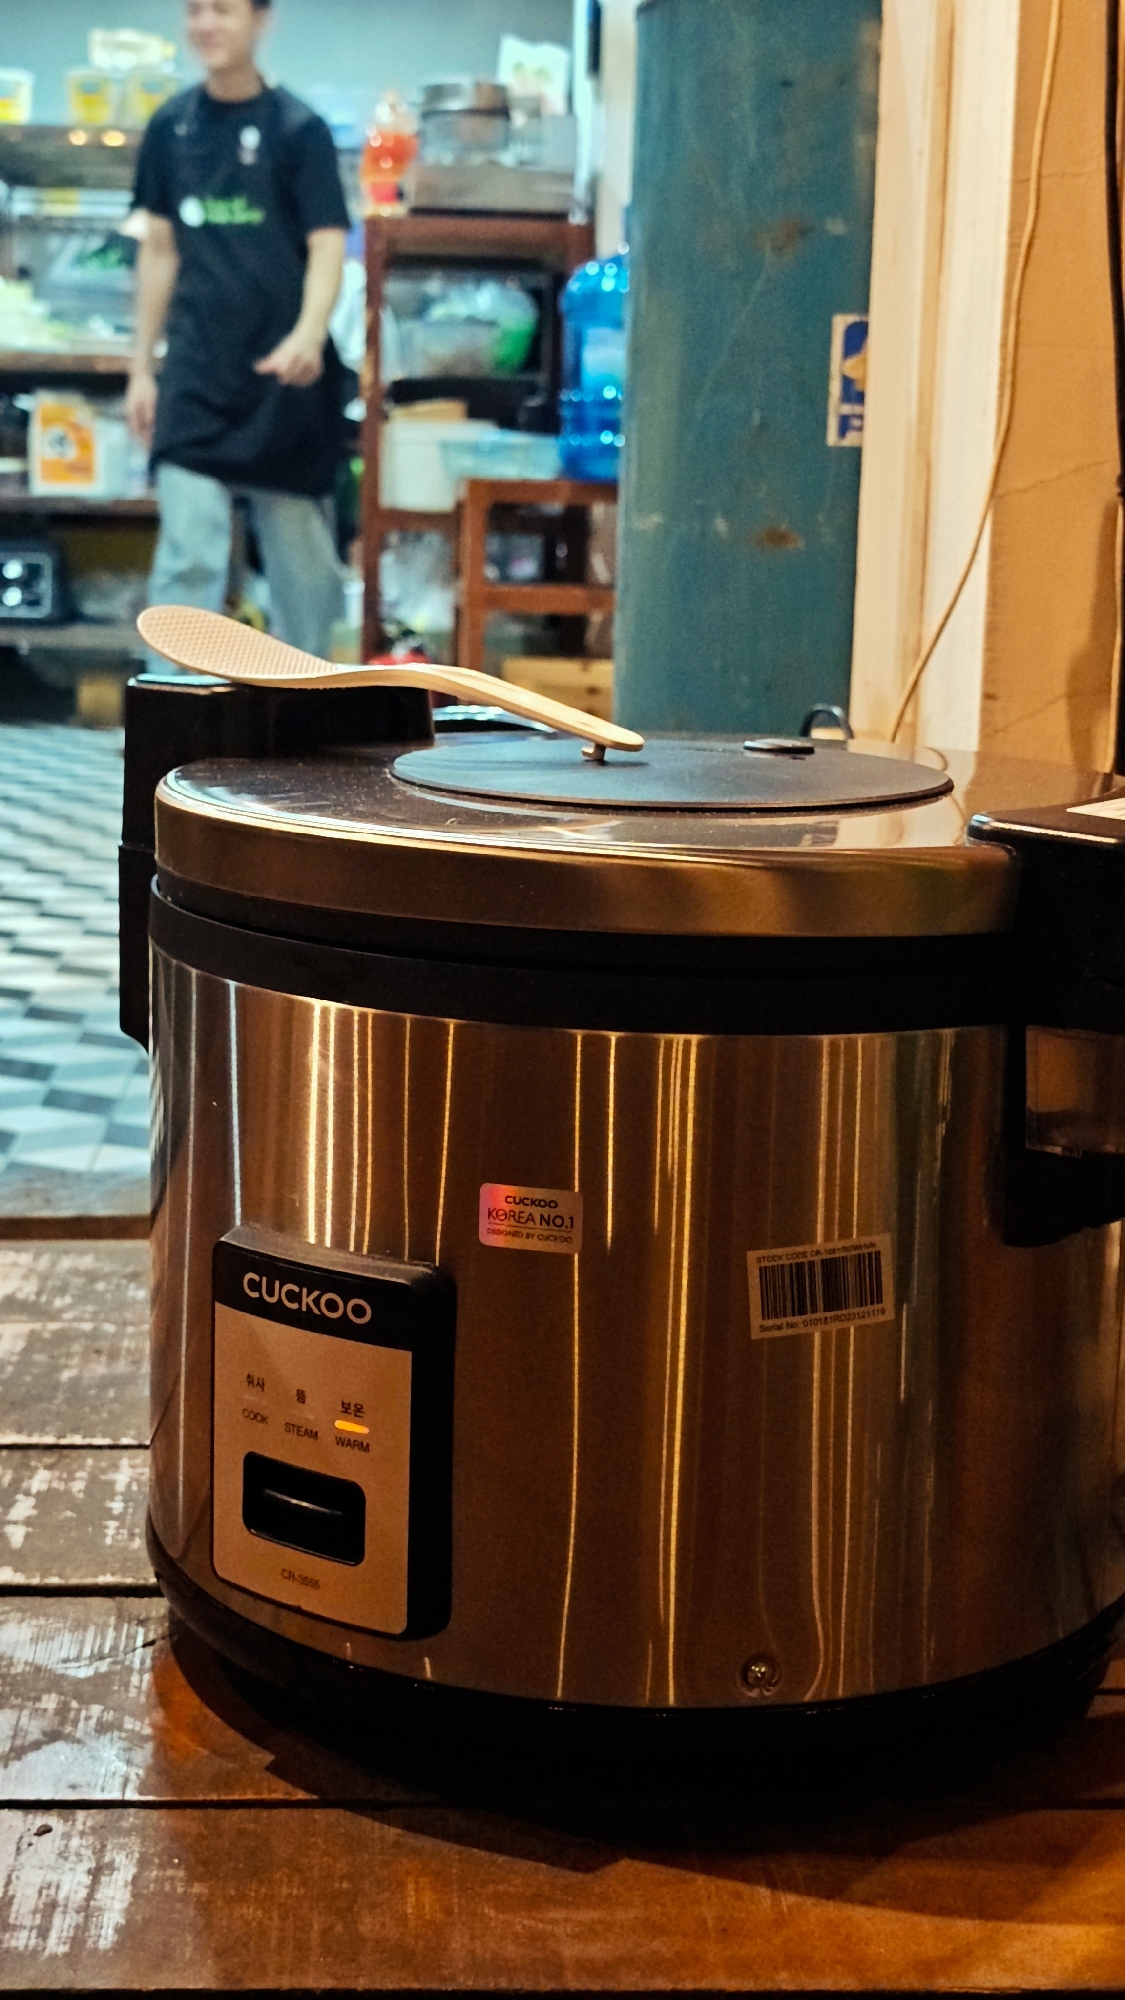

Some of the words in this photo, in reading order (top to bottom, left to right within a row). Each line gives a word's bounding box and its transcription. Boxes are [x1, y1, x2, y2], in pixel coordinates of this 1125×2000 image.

[505, 1195, 558, 1209] CUCKOO
[487, 1207, 536, 1225] KOREA
[540, 1213, 574, 1229] NO.1
[487, 1227, 524, 1239] DESIGNED
[525, 1232, 535, 1240] BY
[537, 1233, 573, 1243] CUCKOO
[755, 1255, 784, 1264] STOCK
[786, 1251, 808, 1260] CODE
[243, 1272, 372, 1324] CUCKOO
[759, 1322, 783, 1332] Serial
[242, 1408, 268, 1425] COOK
[340, 1400, 366, 1419] 보온
[284, 1421, 319, 1441] STEAM
[335, 1436, 370, 1453] WARM
